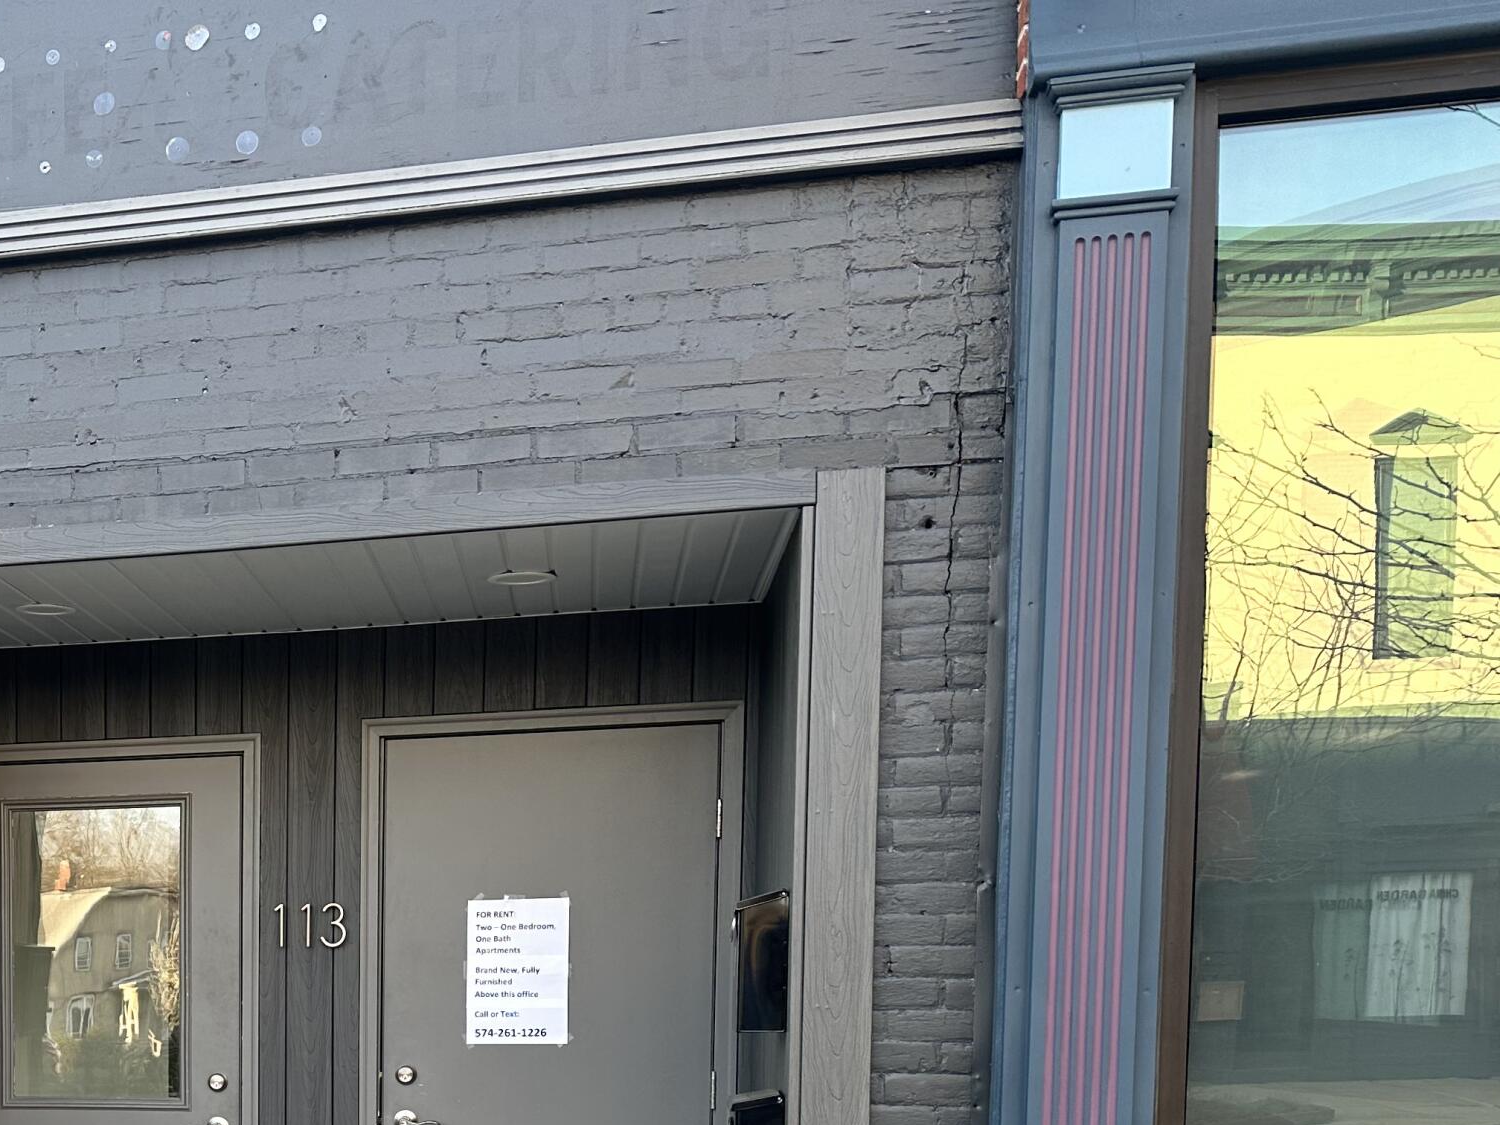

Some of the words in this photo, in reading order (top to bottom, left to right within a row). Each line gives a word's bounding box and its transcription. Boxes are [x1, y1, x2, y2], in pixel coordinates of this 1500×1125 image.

[476, 911, 492, 919] FOR
[274, 902, 347, 948] 113
[500, 923, 517, 931] One
[475, 935, 492, 943] One
[493, 934, 512, 942] Bath
[475, 947, 521, 955] Apartments
[475, 966, 498, 974] Brand
[521, 966, 541, 975] Fully
[475, 978, 513, 986] Furnished
[474, 990, 499, 998] Above
[501, 990, 516, 998] this
[517, 990, 539, 998] office
[474, 1010, 489, 1018] Call
[474, 1027, 547, 1038] 574-261-1226
